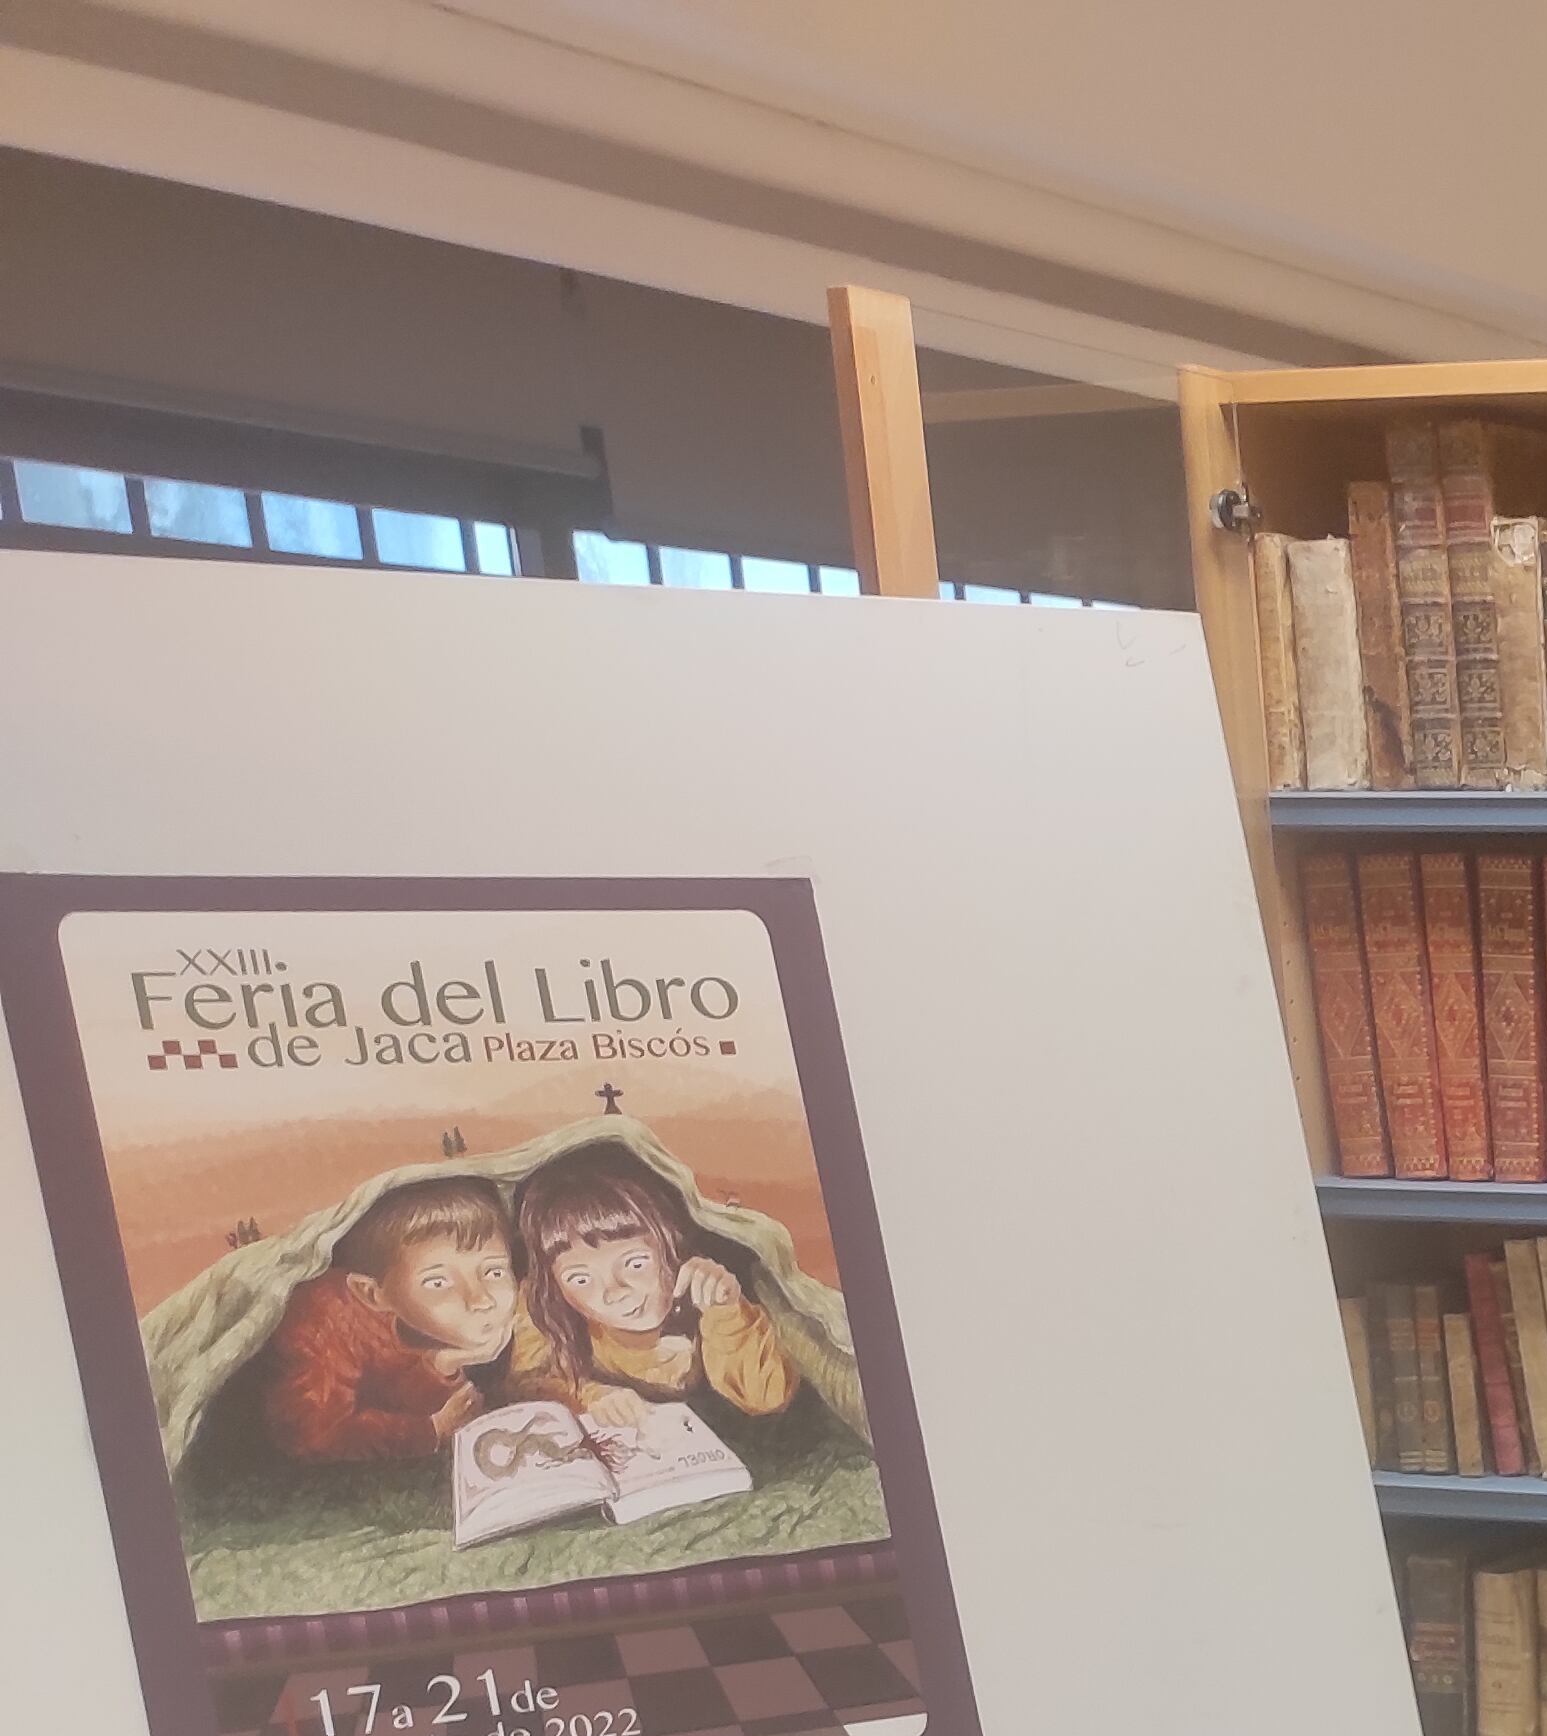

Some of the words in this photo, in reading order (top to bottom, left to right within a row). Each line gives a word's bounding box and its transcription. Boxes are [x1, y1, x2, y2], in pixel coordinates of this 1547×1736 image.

[176, 947, 287, 976] XXIII.
[130, 967, 349, 1031] Feria
[380, 959, 506, 1026] del
[535, 957, 740, 1025] Libro
[247, 1021, 321, 1068] de
[344, 1025, 471, 1066] Jaca
[483, 1032, 580, 1063] Plaza
[591, 1025, 711, 1061] Biscós
[391, 1703, 414, 1730] a
[426, 1667, 501, 1725] 21
[510, 1679, 560, 1713] de
